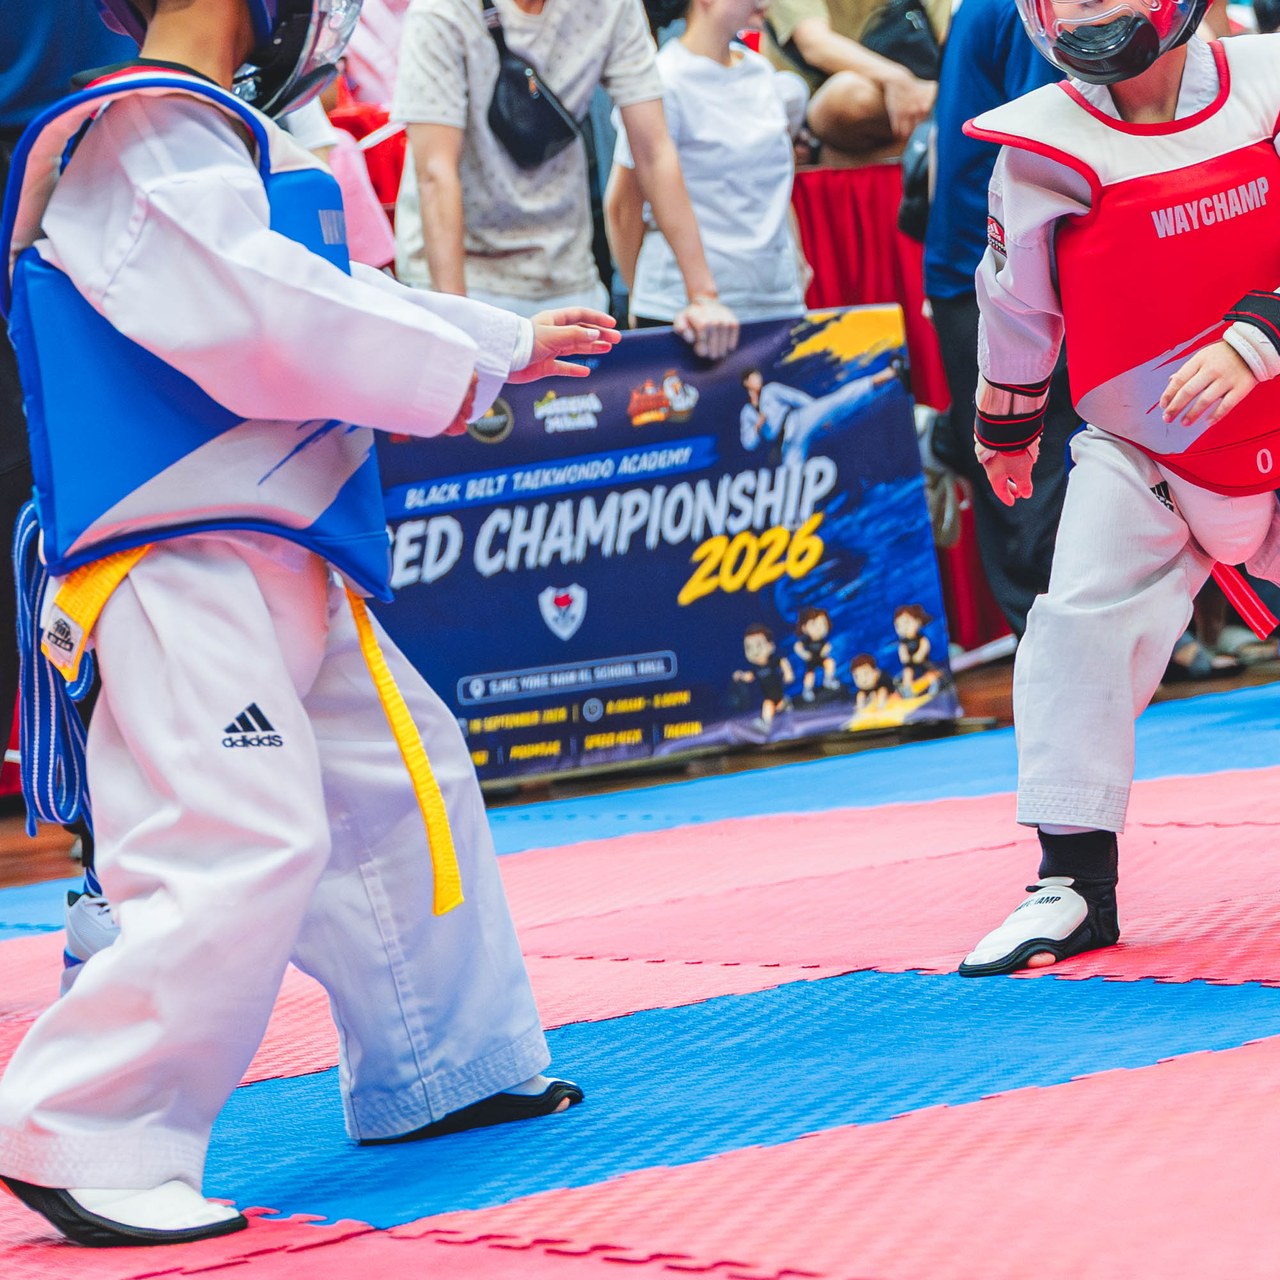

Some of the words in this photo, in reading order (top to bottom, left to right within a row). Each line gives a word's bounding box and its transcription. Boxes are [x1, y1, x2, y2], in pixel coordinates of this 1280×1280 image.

[1151, 176, 1269, 238] WAYCHAMP
[404, 483, 461, 510] BLACK
[465, 474, 507, 501] BELT
[512, 458, 615, 491] TAEKWONDO
[616, 445, 693, 475] ACADEMY
[387, 515, 464, 589] ED
[473, 456, 838, 579] CHAMPIONSHIP
[677, 512, 825, 607] 2026
[222, 734, 283, 748] adidas
